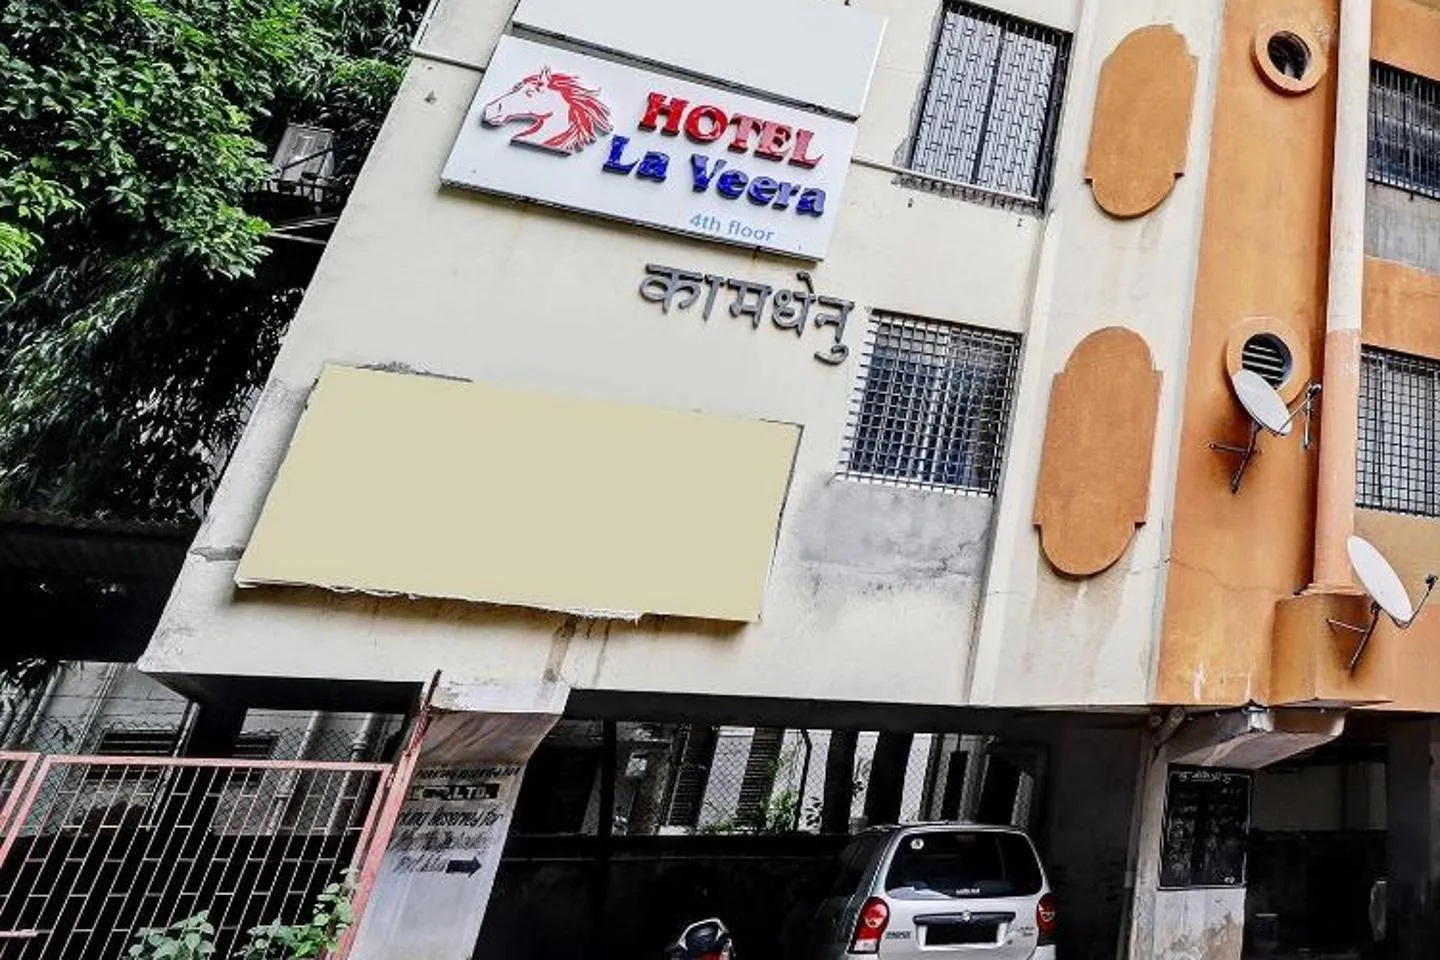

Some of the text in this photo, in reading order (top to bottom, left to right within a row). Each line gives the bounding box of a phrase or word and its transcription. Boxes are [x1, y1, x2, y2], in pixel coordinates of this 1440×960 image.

[638, 91, 824, 168] HOTEL
[602, 135, 827, 218] La Veera
[689, 213, 775, 241] 4th floor
[639, 263, 855, 364] कामधेनु
